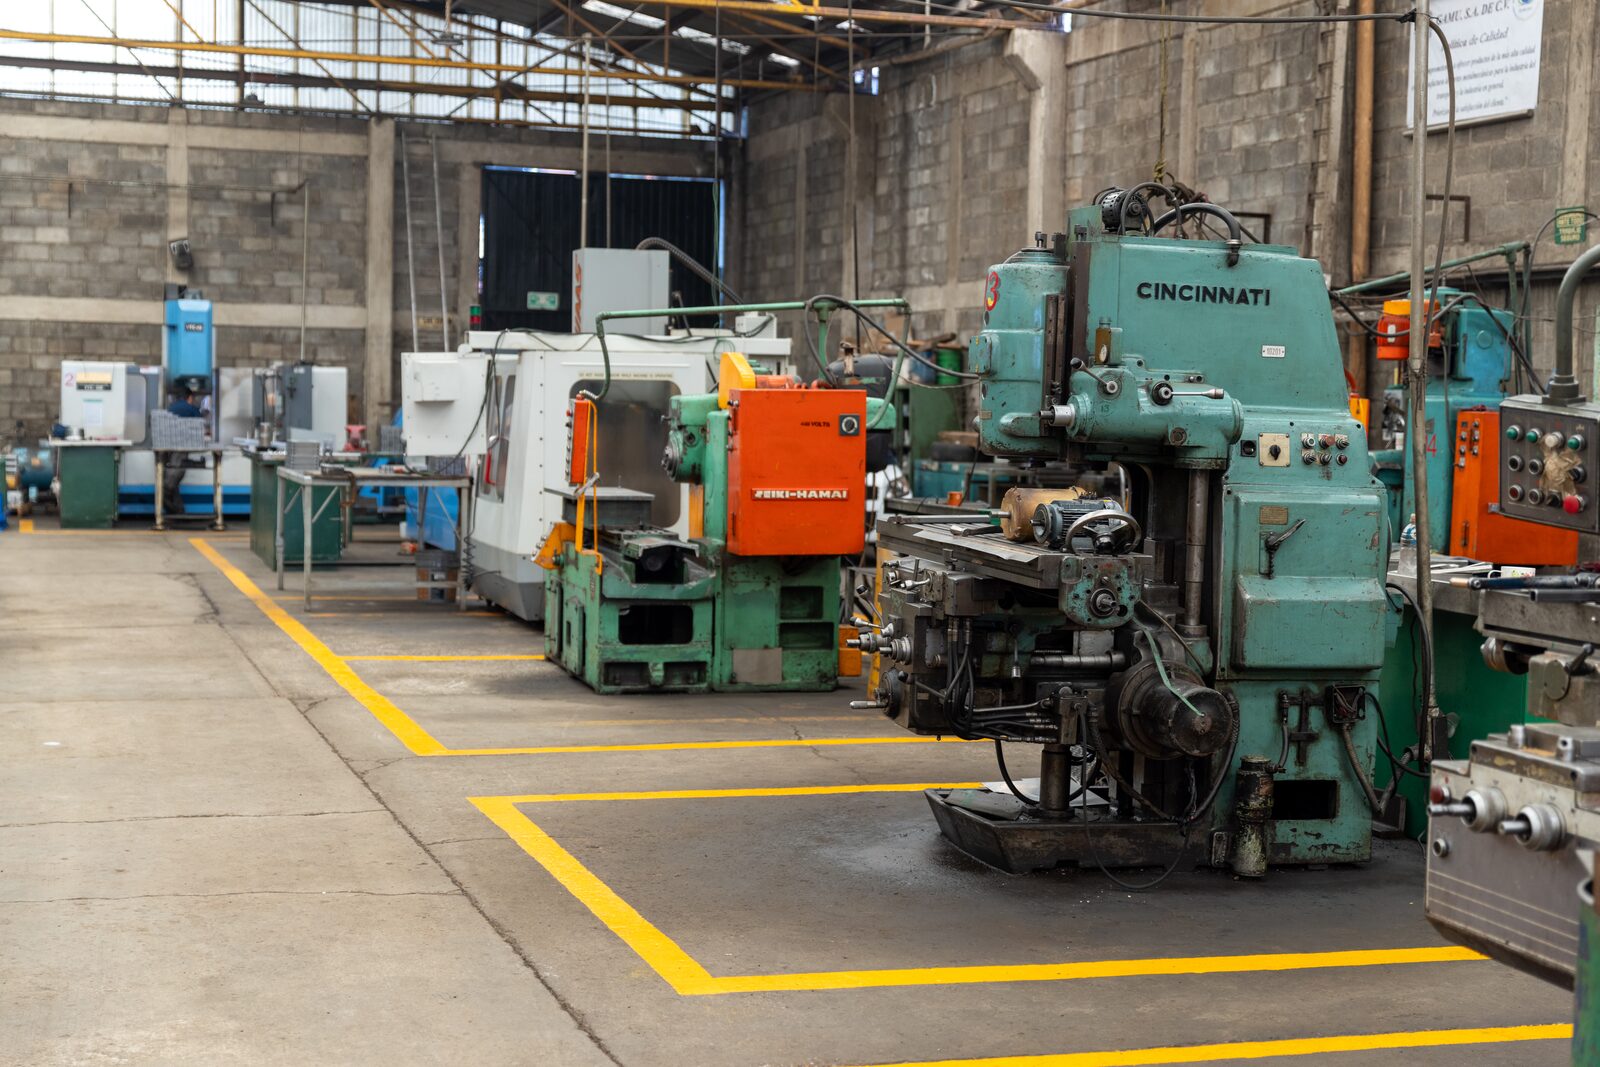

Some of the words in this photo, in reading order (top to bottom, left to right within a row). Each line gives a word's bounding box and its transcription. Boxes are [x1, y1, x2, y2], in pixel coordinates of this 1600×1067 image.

[1481, 3, 1495, 15] DE
[1480, 26, 1509, 43] Calidad
[1137, 282, 1270, 306] CINCINNATI
